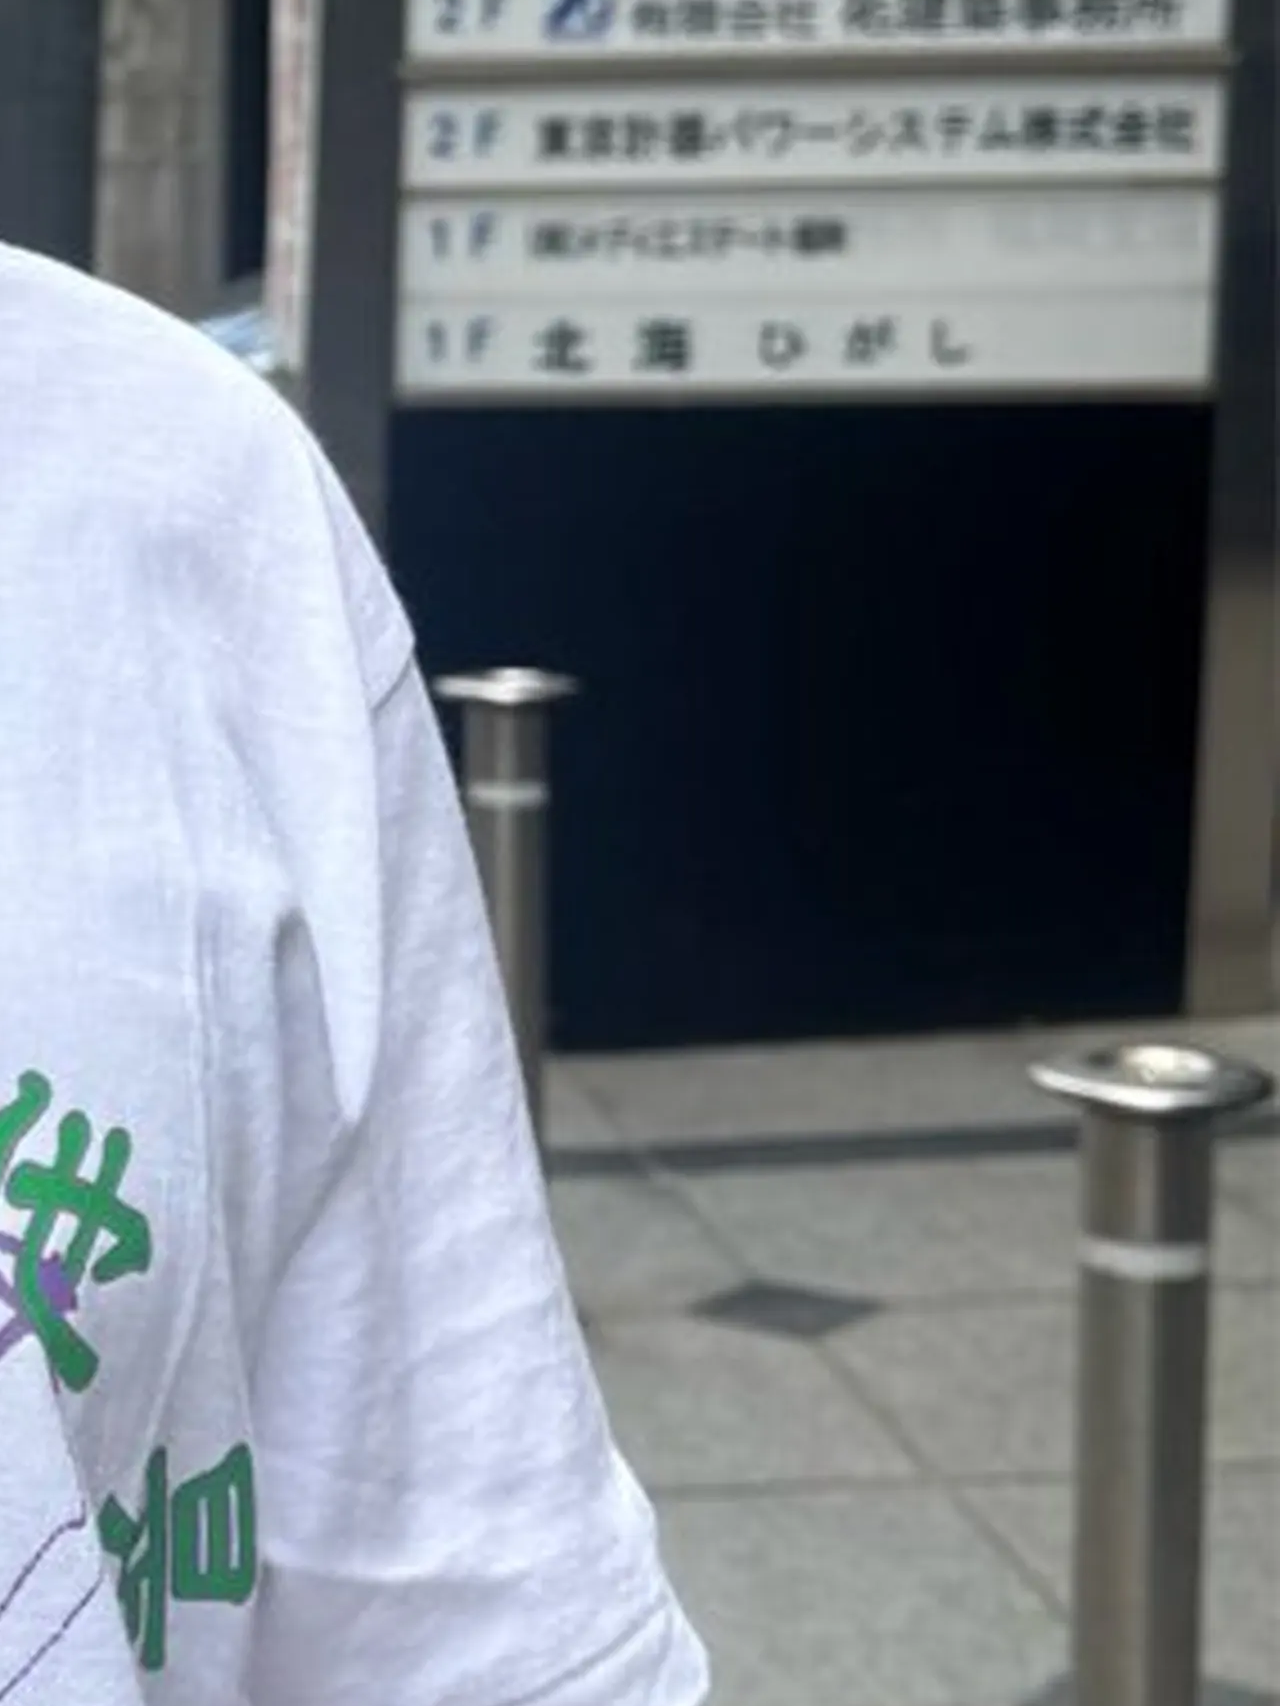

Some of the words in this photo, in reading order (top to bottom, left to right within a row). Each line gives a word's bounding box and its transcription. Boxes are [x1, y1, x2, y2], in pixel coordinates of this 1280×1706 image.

[425, 111, 504, 161] 2F
[426, 213, 496, 259] 1F
[426, 317, 492, 363] 1F
